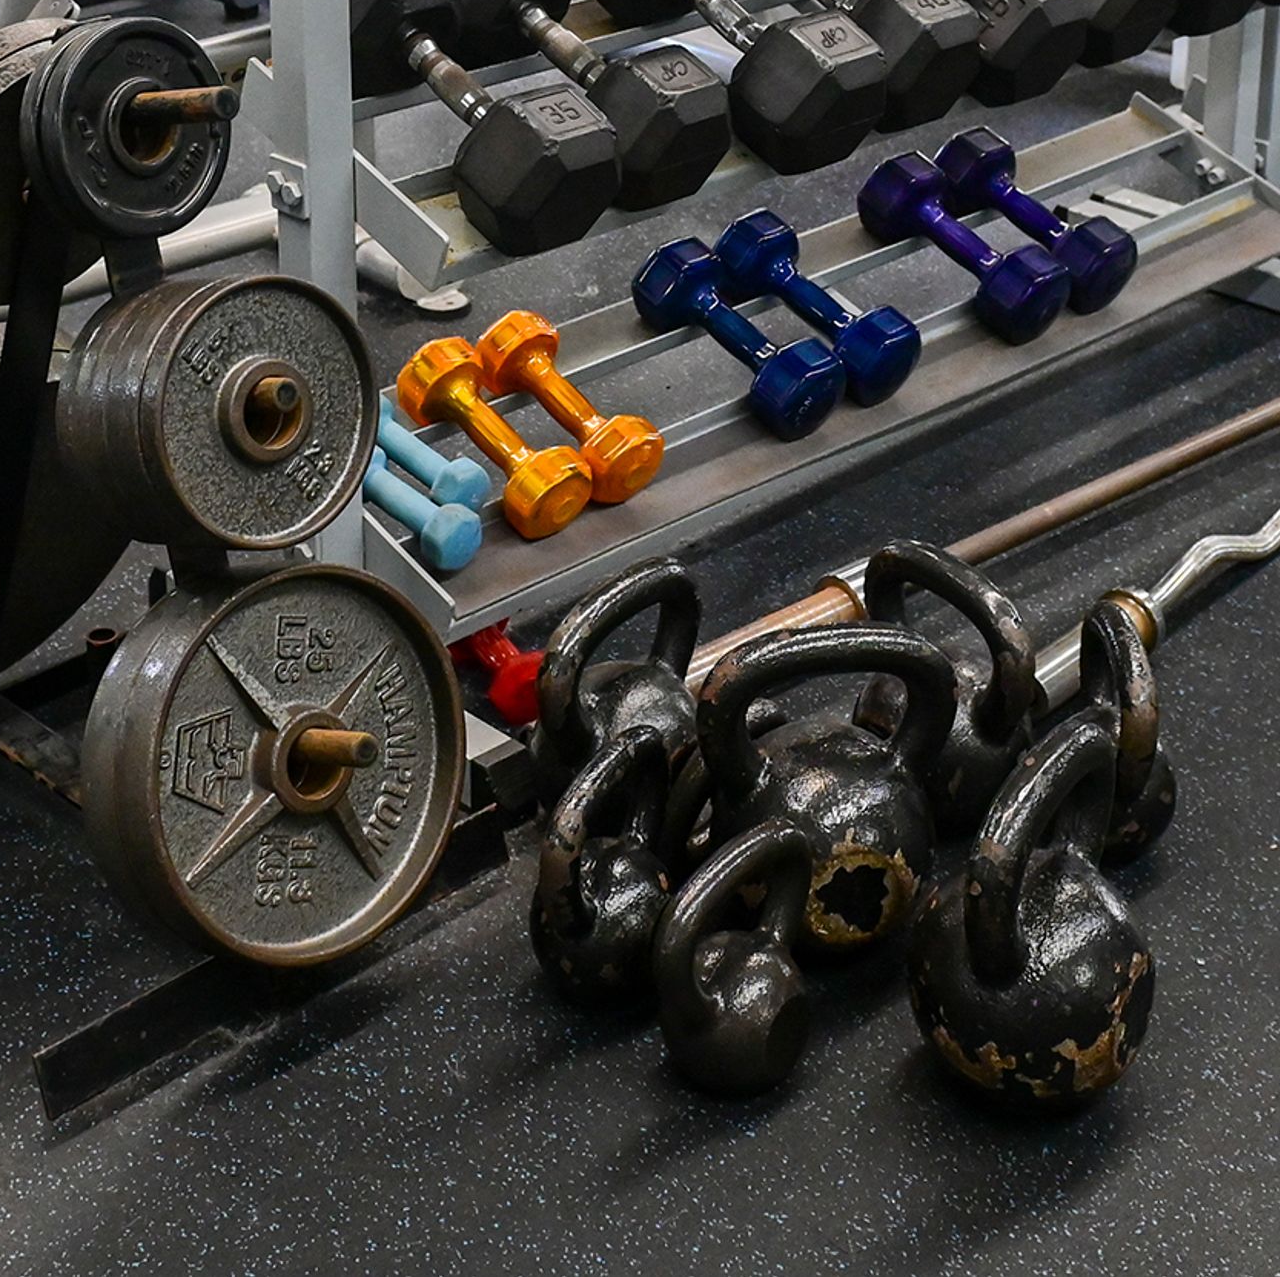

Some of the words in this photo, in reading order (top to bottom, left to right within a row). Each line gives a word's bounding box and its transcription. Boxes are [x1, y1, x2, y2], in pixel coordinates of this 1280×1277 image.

[538, 99, 581, 125] 35
[274, 614, 308, 684] LBS
[307, 626, 337, 672] 25
[362, 661, 419, 859] HAMPTON
[254, 833, 289, 908] KGS
